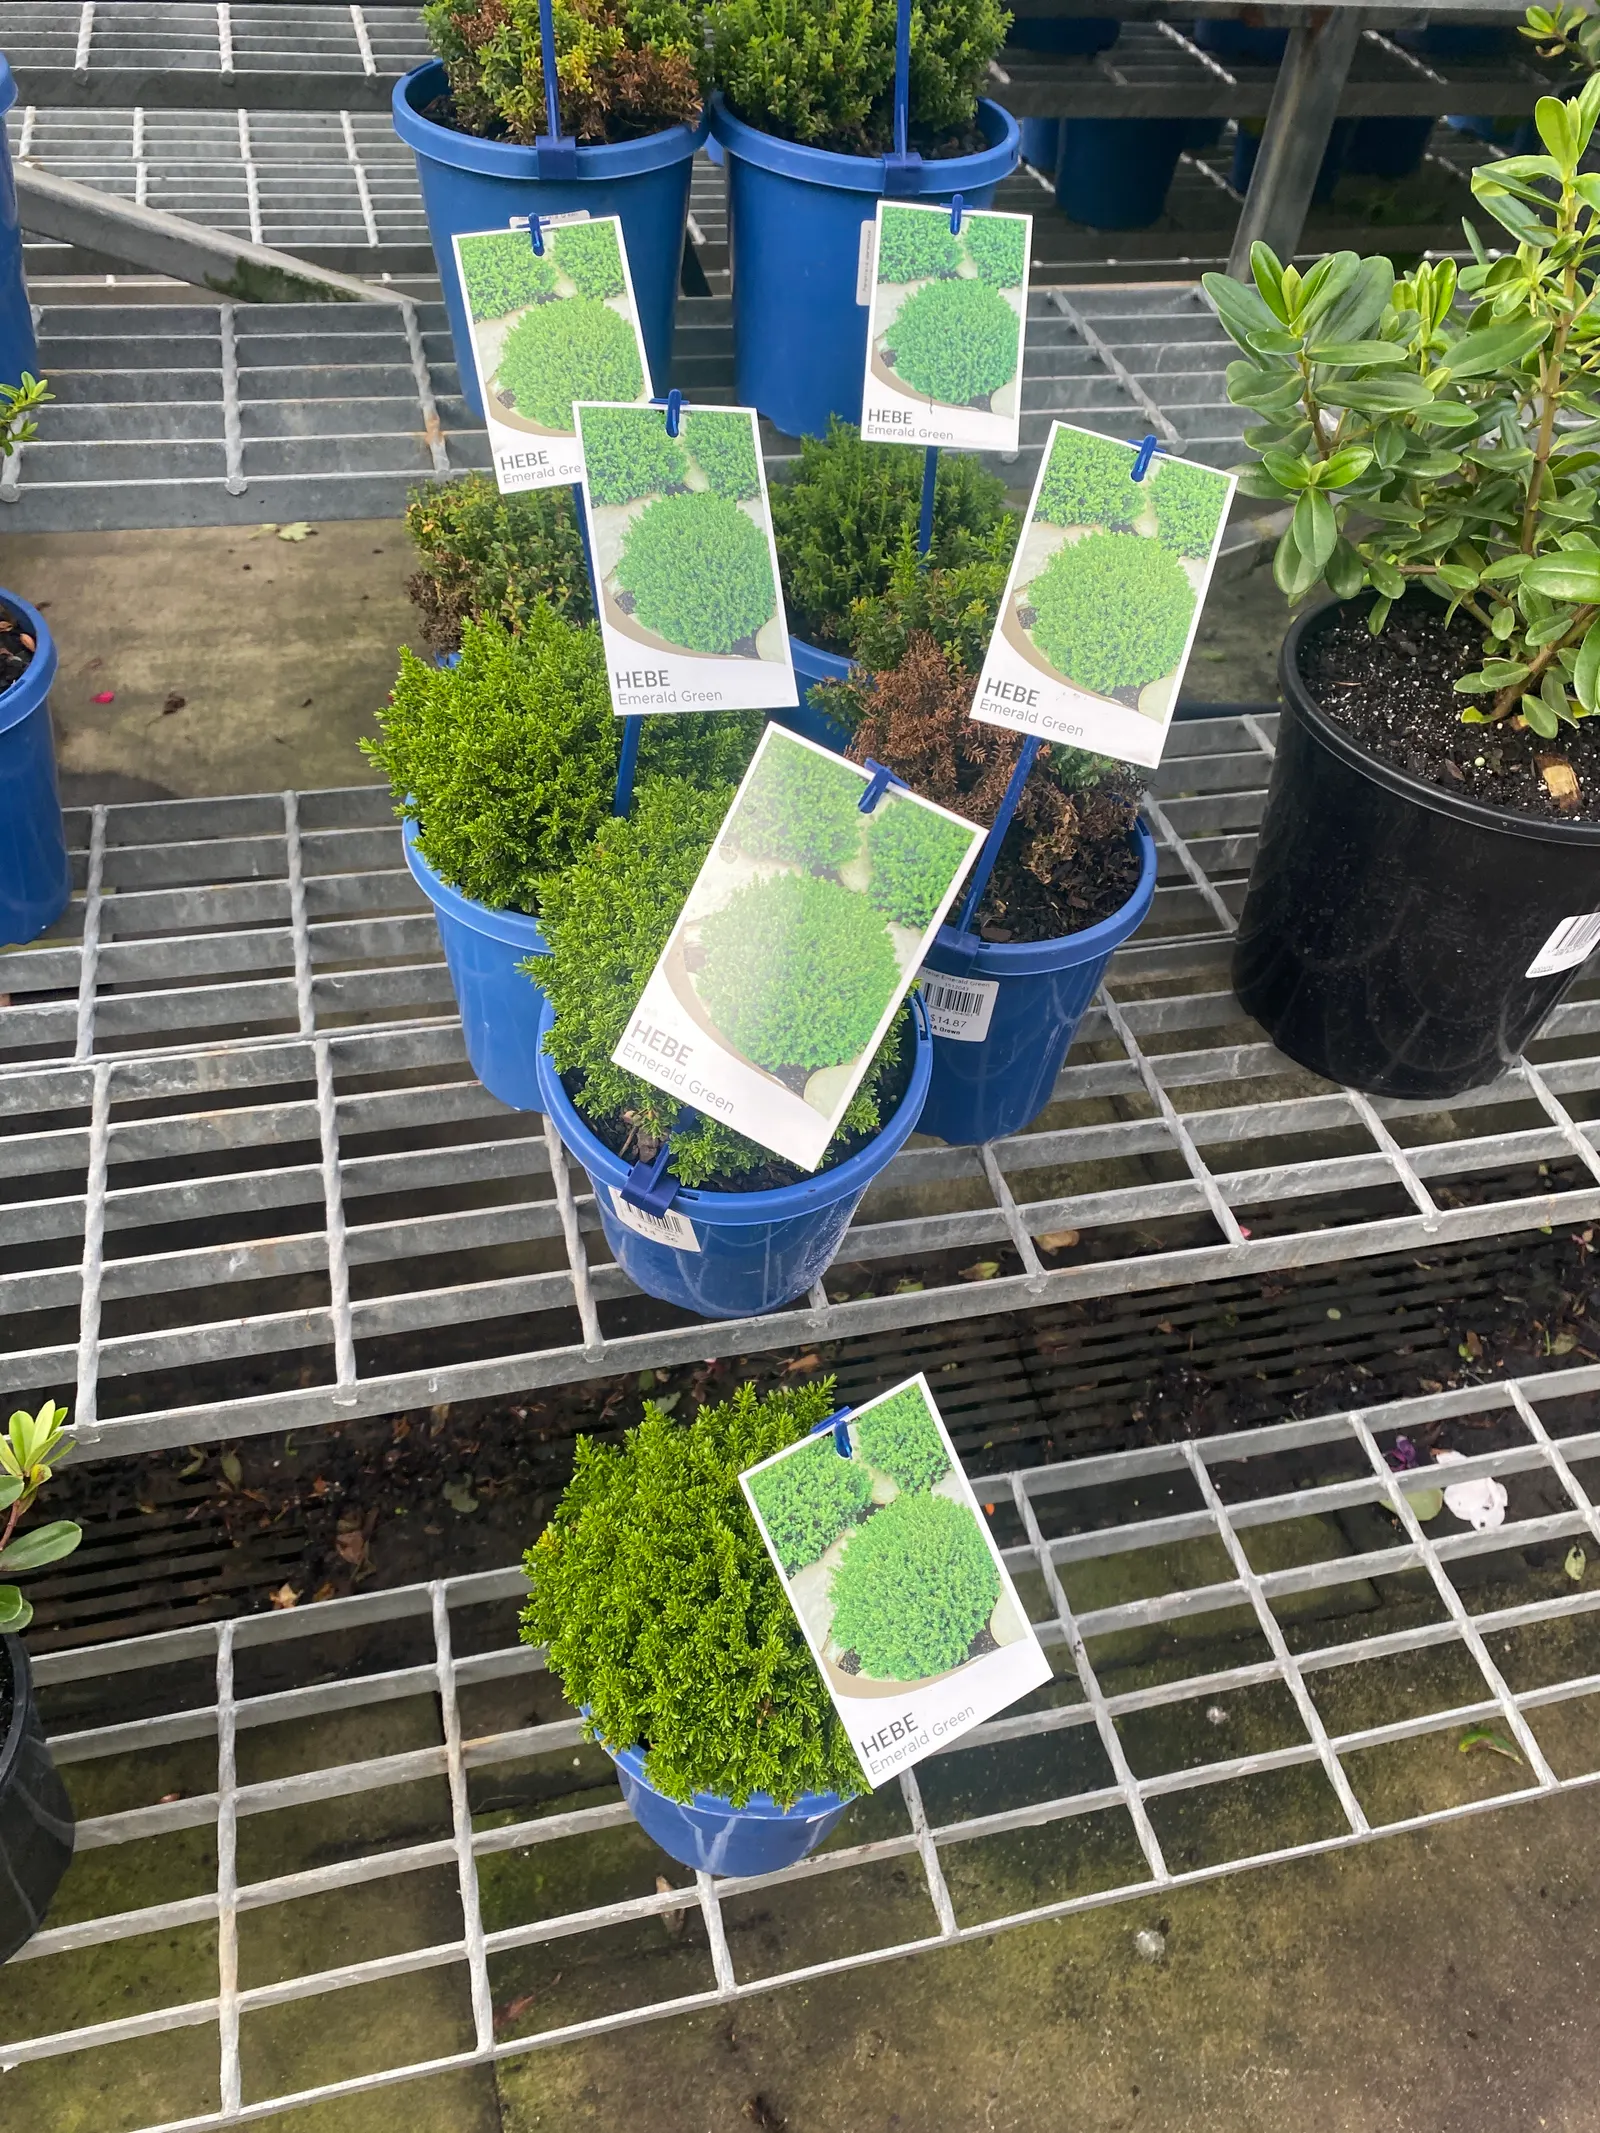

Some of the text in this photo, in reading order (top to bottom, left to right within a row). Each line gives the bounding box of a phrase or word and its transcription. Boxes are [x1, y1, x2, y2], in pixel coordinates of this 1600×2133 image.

[868, 408, 913, 425] HEBE
[867, 424, 954, 440] Emerald Green
[500, 450, 549, 471] HEBE
[503, 465, 581, 484] Emerald Gre
[615, 670, 670, 689] HEBE
[984, 677, 1041, 707] HEBE
[618, 690, 723, 706] Emerald Green
[980, 698, 1084, 737] Emerald Green
[631, 1019, 694, 1067] HEBE
[622, 1042, 735, 1114] Emerald Green
[860, 1712, 919, 1758] HEBE
[869, 1706, 975, 1775] Emerald Green
